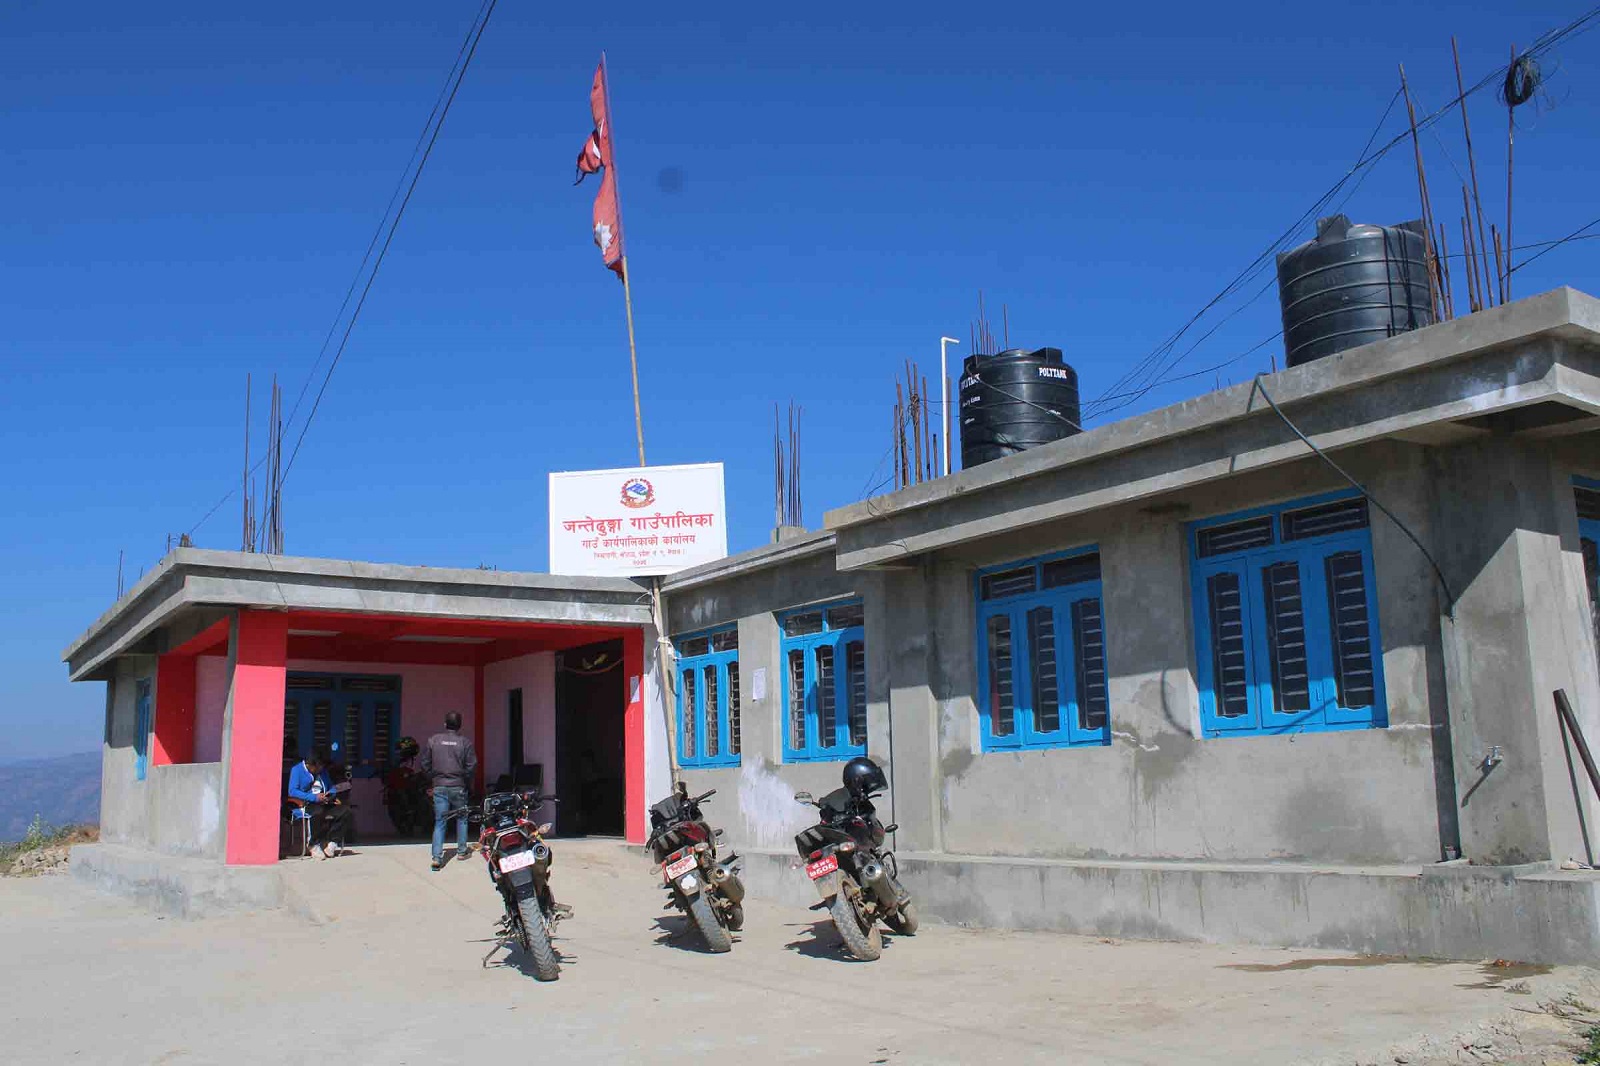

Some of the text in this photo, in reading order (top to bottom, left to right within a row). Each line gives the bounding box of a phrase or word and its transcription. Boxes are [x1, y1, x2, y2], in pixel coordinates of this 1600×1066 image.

[629, 511, 714, 530] गाउँपालिका
[581, 533, 696, 550] गाउँ कार्यपालिकाको कार्यालय
